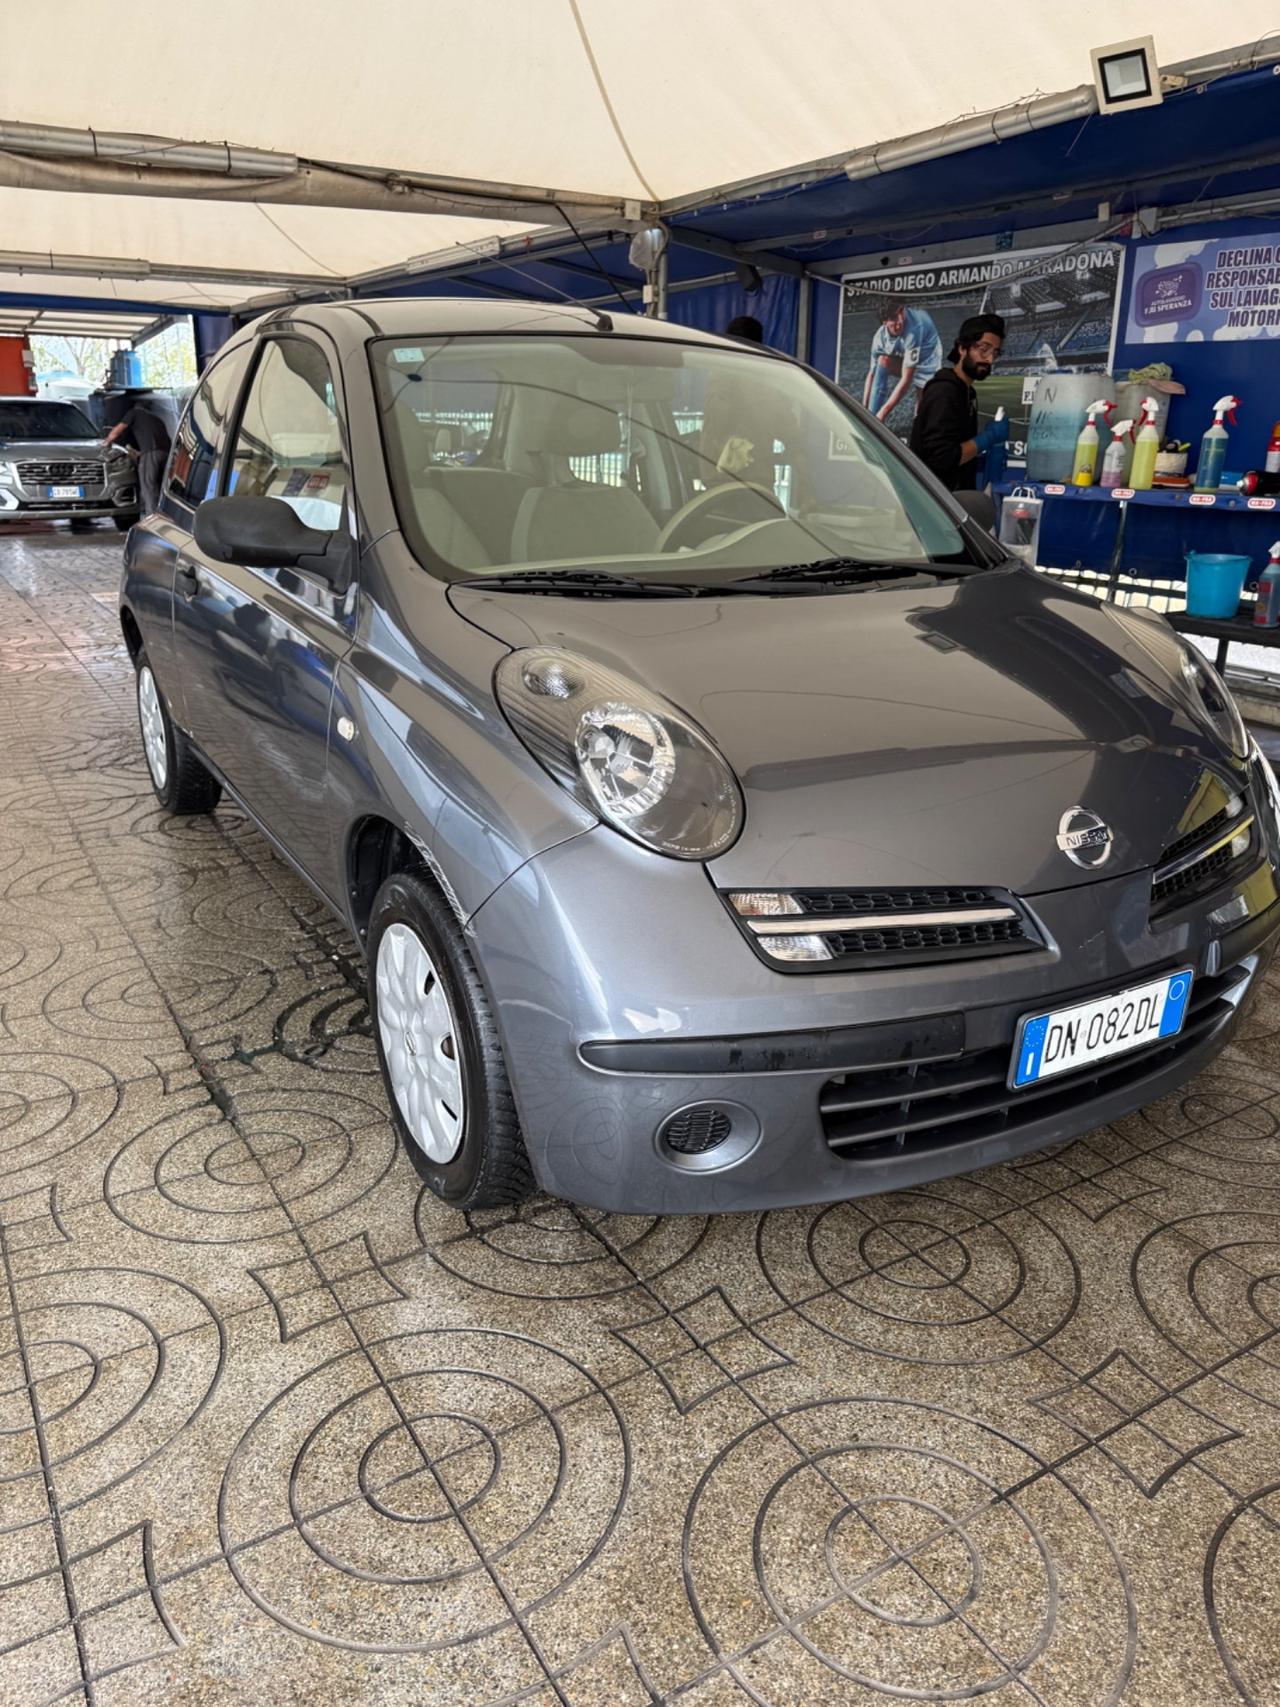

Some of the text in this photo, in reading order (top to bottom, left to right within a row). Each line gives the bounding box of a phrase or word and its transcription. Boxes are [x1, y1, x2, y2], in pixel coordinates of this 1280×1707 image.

[1217, 247, 1272, 268] DECLINA
[847, 250, 1115, 297] STADIO DIEGO ARMANDO MARADONA
[1157, 299, 1192, 312] SPERANZA
[1211, 287, 1280, 308] SUL LAVAG
[1066, 829, 1108, 847] NISSAN
[1044, 994, 1159, 1063] DN 082DL
